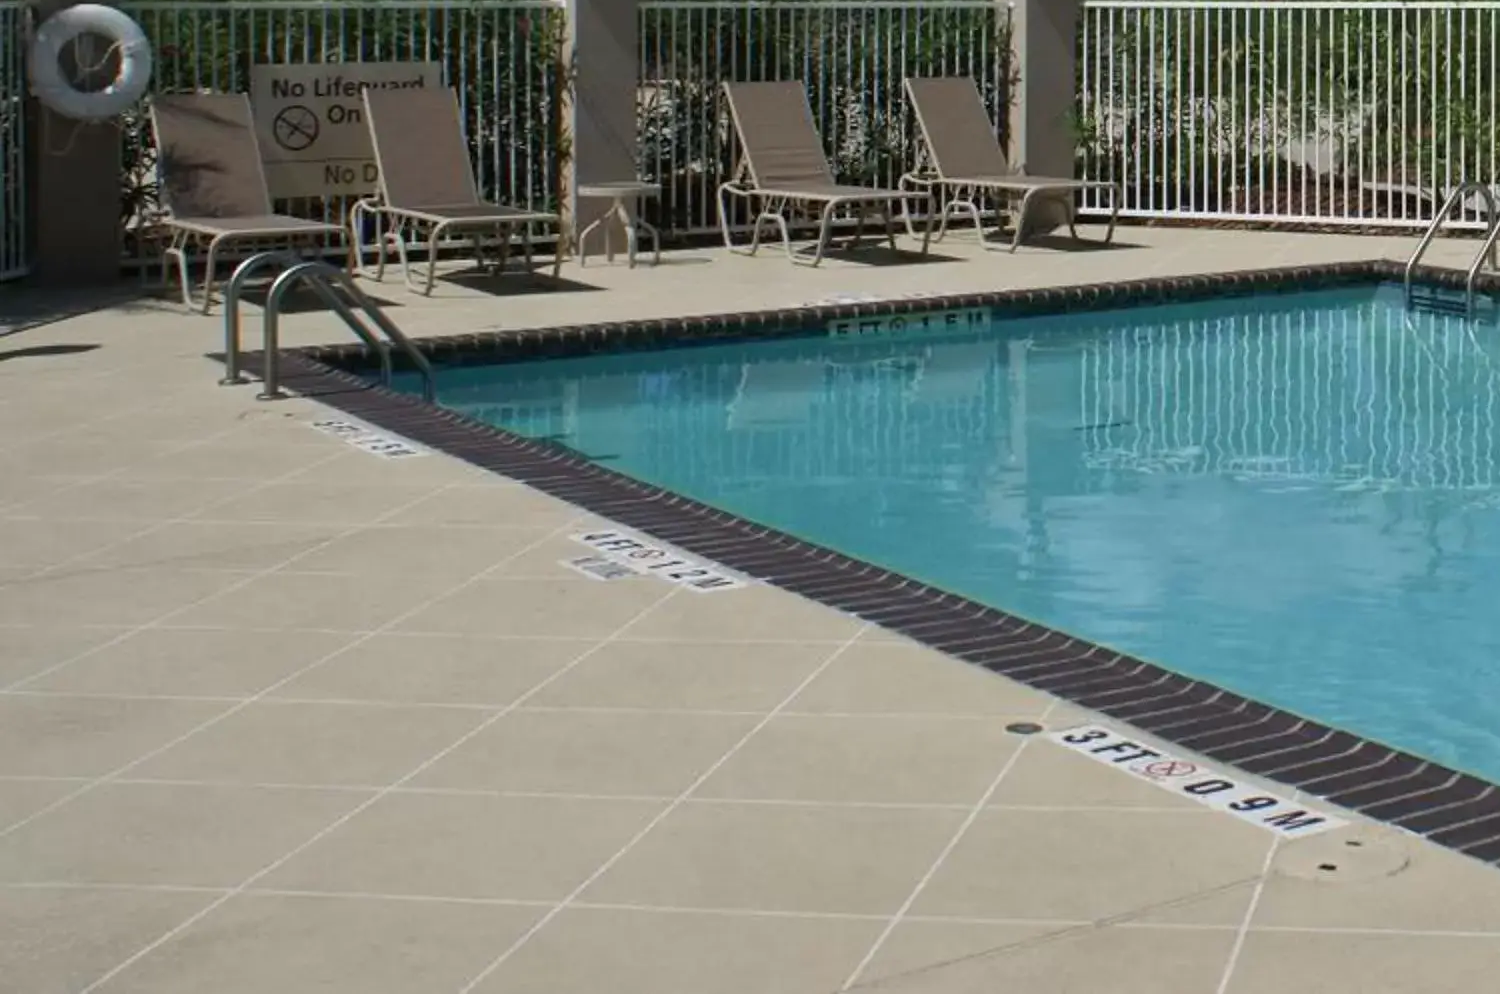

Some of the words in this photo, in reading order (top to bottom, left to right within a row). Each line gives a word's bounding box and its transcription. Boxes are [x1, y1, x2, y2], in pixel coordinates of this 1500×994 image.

[271, 78, 305, 98] No
[327, 103, 361, 124] On
[325, 164, 356, 184] No
